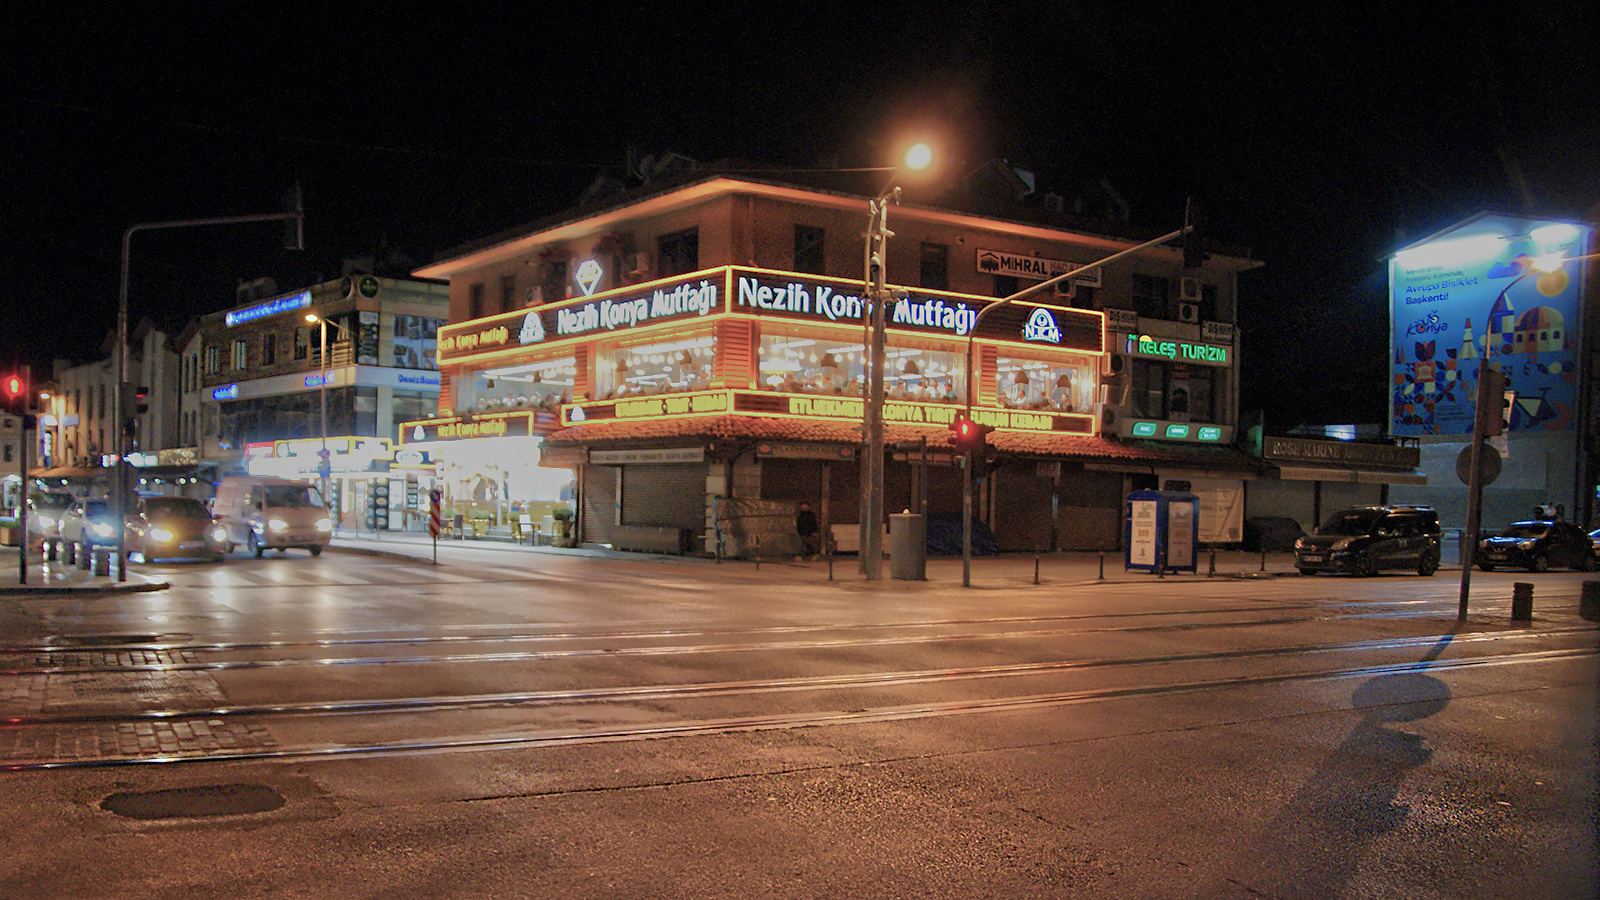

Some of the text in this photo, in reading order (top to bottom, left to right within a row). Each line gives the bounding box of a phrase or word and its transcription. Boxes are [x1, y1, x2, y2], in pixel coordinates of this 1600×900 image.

[1406, 277, 1479, 294] Avrupa Bisiklet
[557, 303, 599, 335] Nezih
[600, 298, 648, 330] Konya
[650, 279, 717, 317] Mutfağı
[737, 276, 809, 313] Nezih
[892, 297, 977, 336] Mutfağı
[1406, 292, 1450, 306] Başkenti!
[1406, 321, 1449, 338] Konya
[1139, 340, 1227, 363] KELEŞ TURİZM
[1272, 441, 1301, 457] ROSE
[1303, 443, 1341, 459] MARINE
